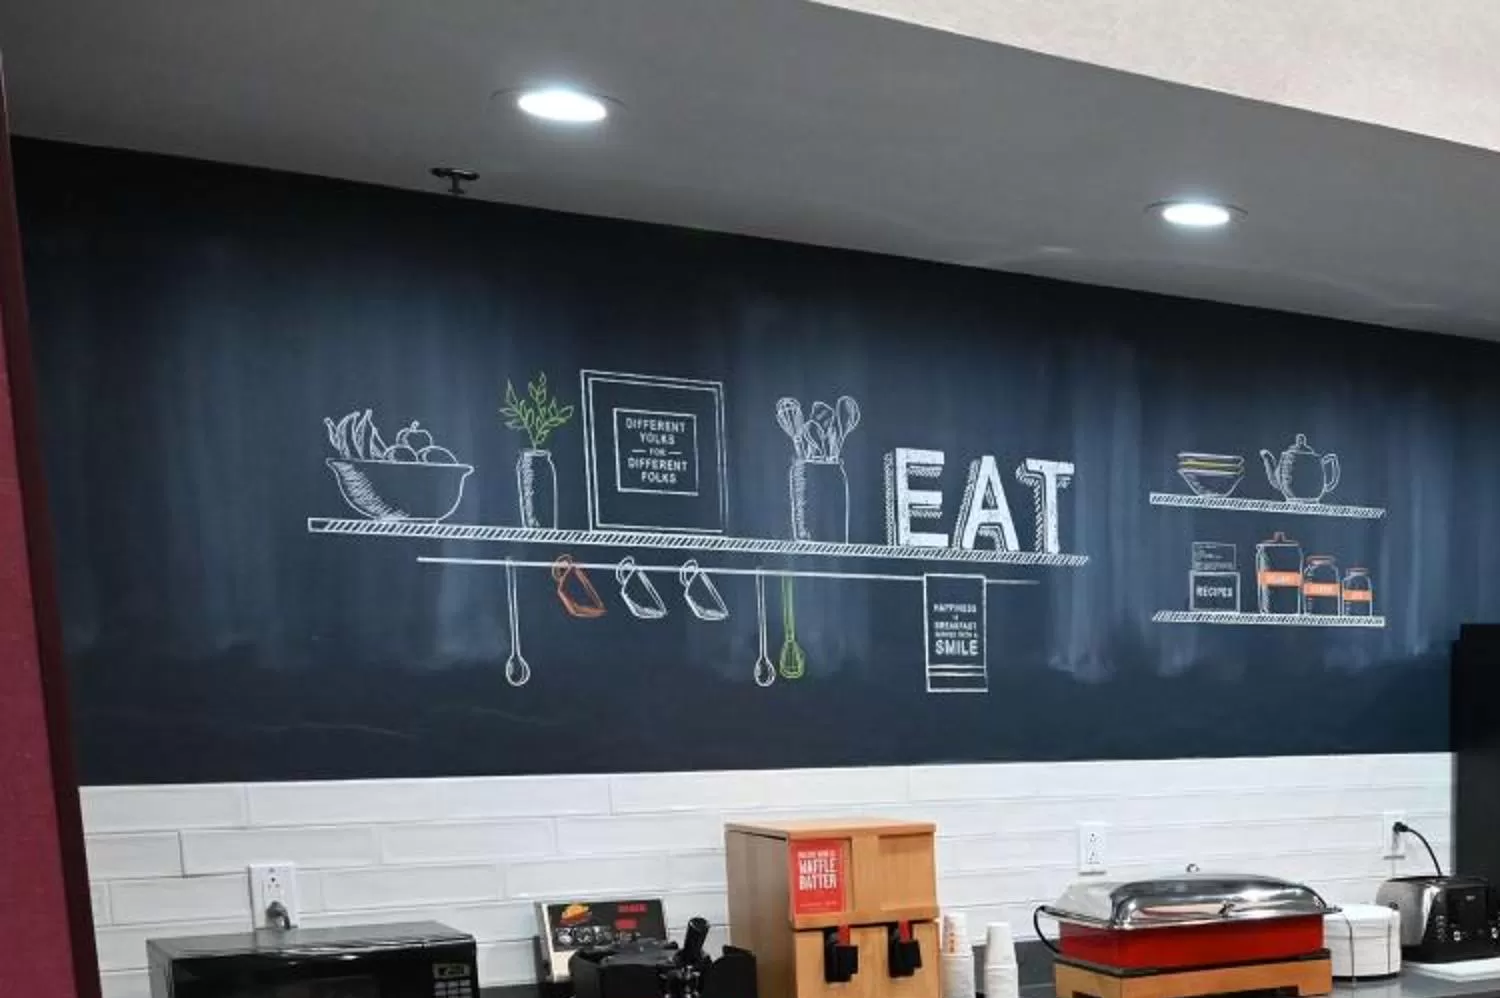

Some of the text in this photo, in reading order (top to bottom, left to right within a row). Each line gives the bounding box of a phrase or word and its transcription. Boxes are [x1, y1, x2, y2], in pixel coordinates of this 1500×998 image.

[625, 417, 686, 433] DIFFERENT
[639, 431, 676, 445] YOLKS
[627, 457, 688, 472] DIFFERENT
[641, 471, 677, 484] FOLKS
[885, 448, 1075, 554] EAT
[1195, 585, 1234, 598] RECIPES
[935, 639, 979, 656] SMILE
[799, 858, 839, 874] WAFFLE
[799, 873, 837, 892] BATTER
